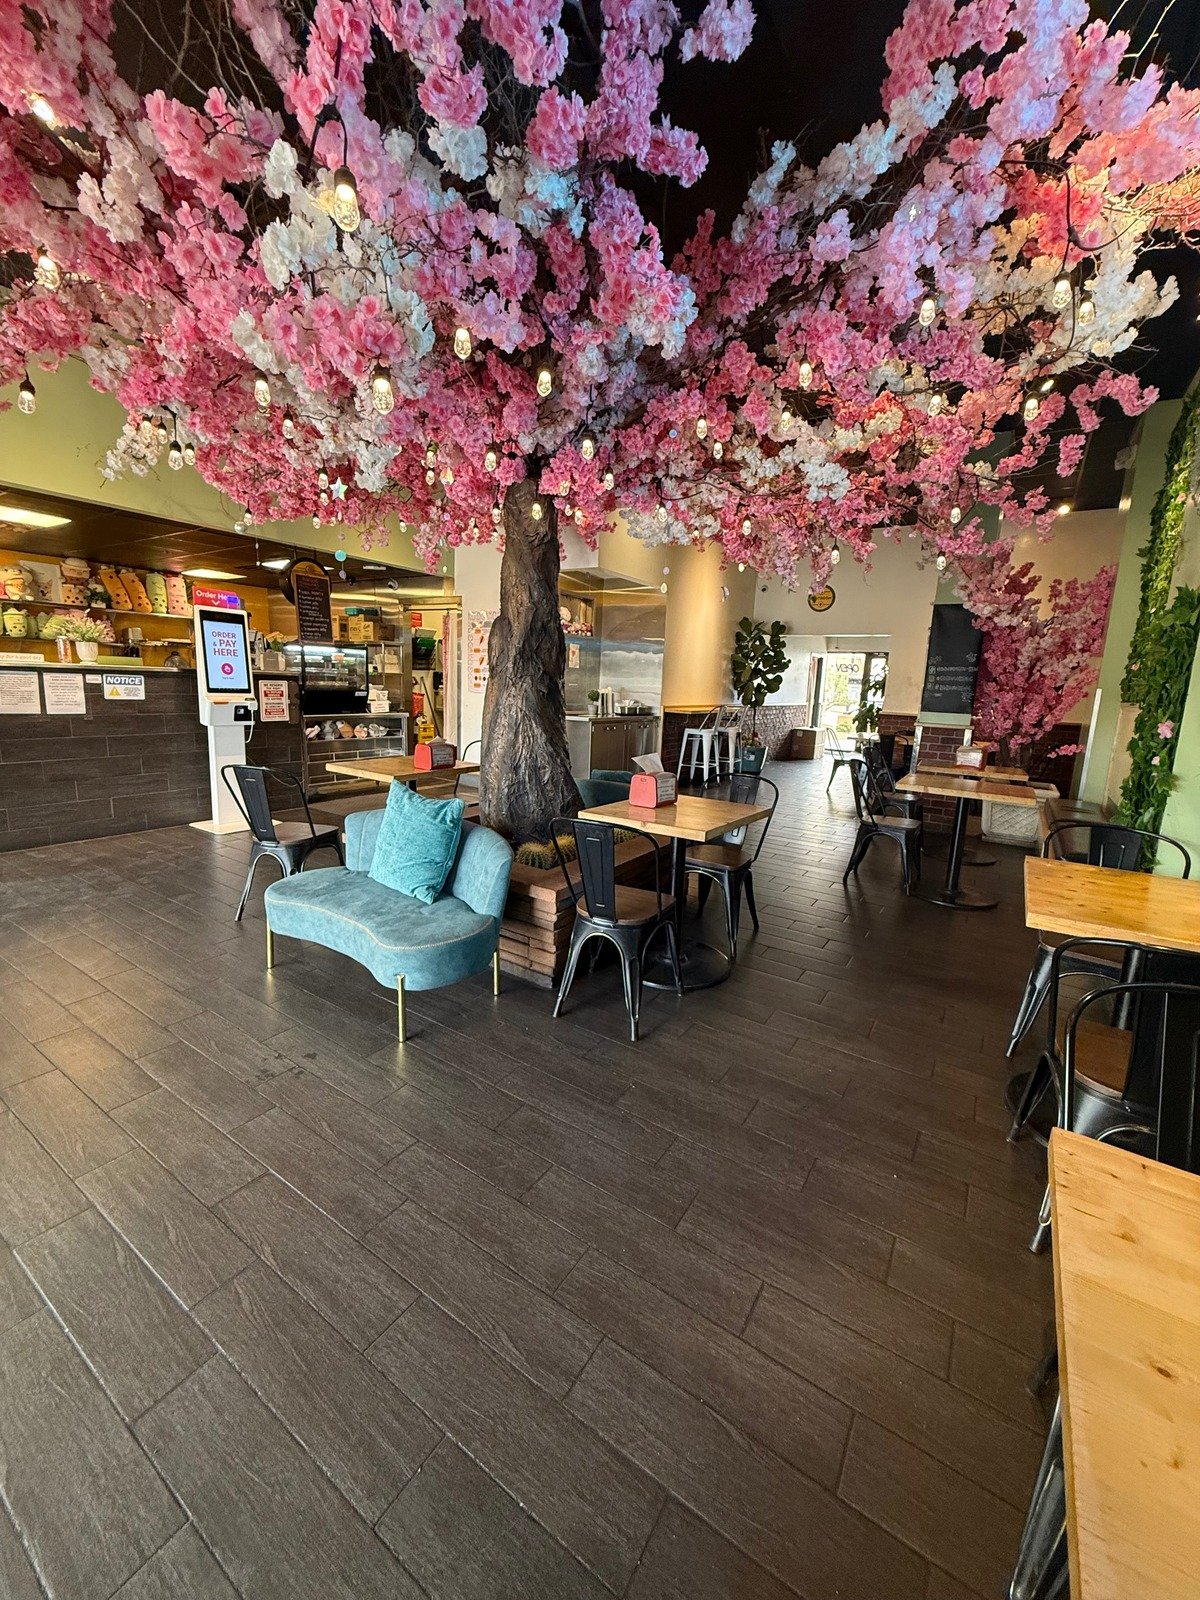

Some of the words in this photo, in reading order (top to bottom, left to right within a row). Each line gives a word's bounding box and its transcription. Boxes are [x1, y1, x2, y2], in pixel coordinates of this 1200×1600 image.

[196, 590, 217, 599] Order
[212, 631, 237, 639] ORDER
[219, 639, 237, 648] PAY
[213, 648, 239, 657] HERE
[106, 676, 142, 685] NOTICE
